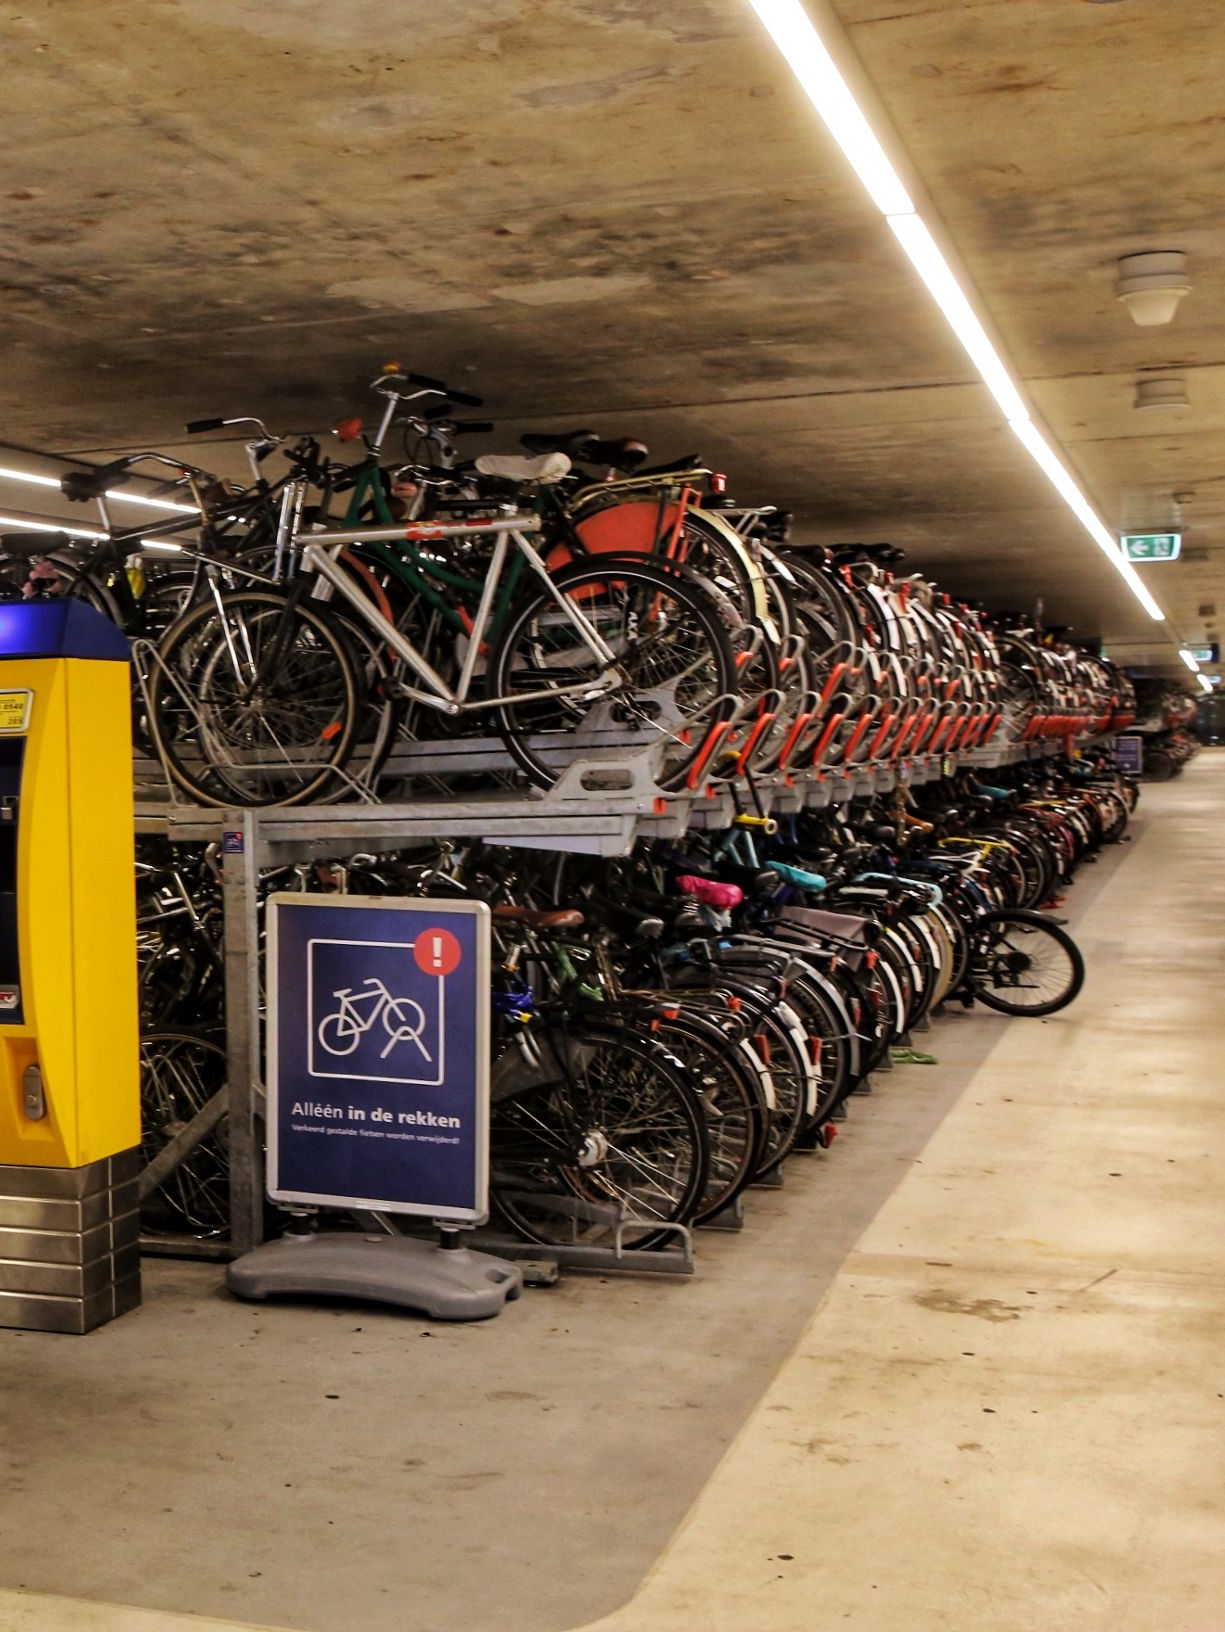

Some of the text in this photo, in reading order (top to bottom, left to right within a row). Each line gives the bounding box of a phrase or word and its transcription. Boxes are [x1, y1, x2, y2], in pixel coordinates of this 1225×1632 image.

[291, 1102, 461, 1128] Alléén in de rekken
